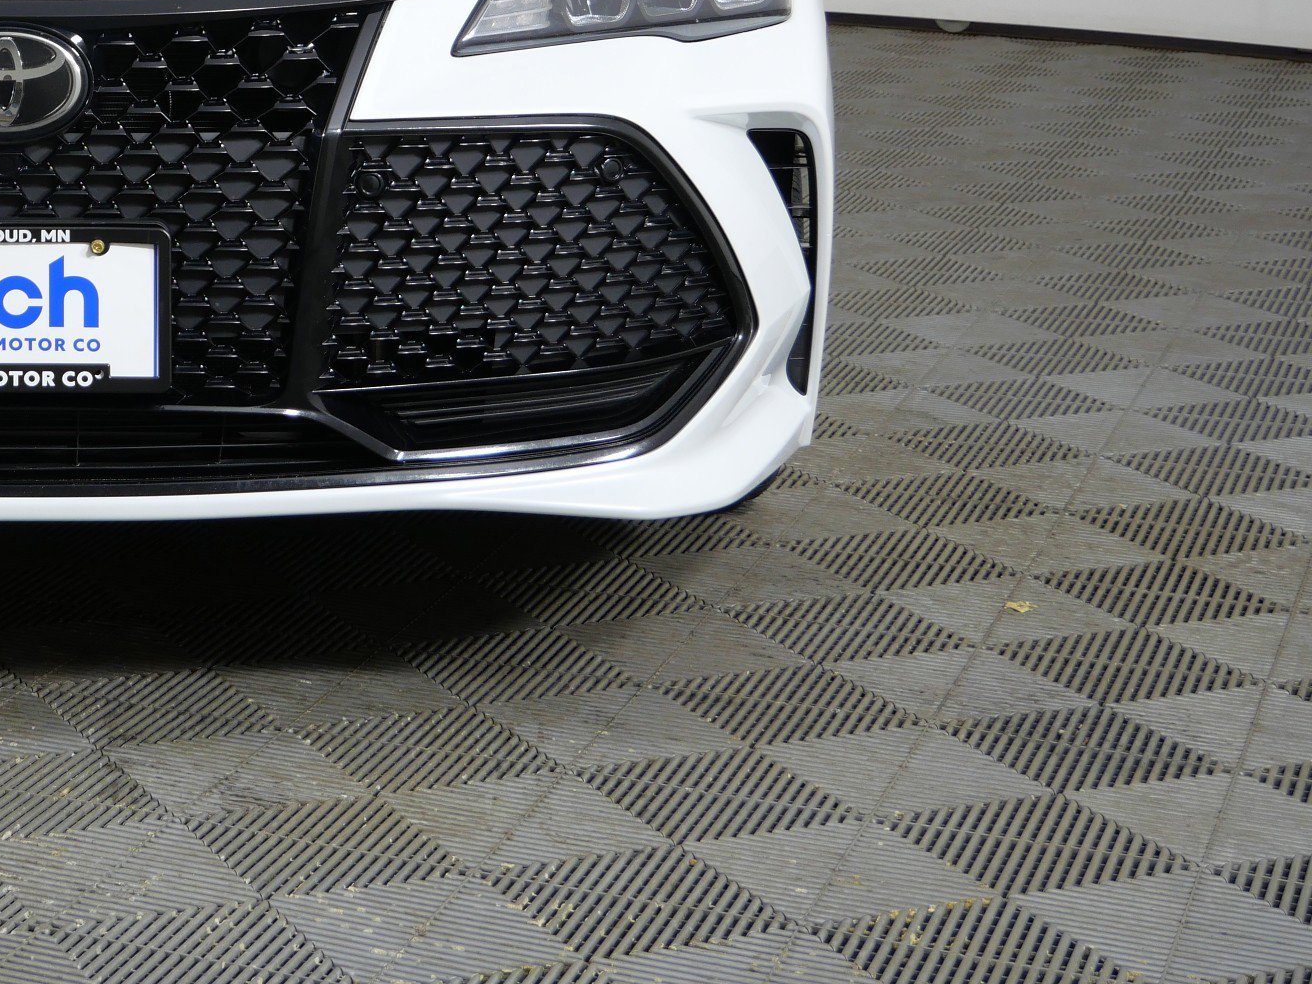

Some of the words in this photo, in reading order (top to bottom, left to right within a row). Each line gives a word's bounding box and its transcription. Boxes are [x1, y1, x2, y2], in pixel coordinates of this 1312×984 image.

[41, 229, 71, 243] MN
[73, 338, 101, 353] CO
[61, 370, 94, 388] CO
